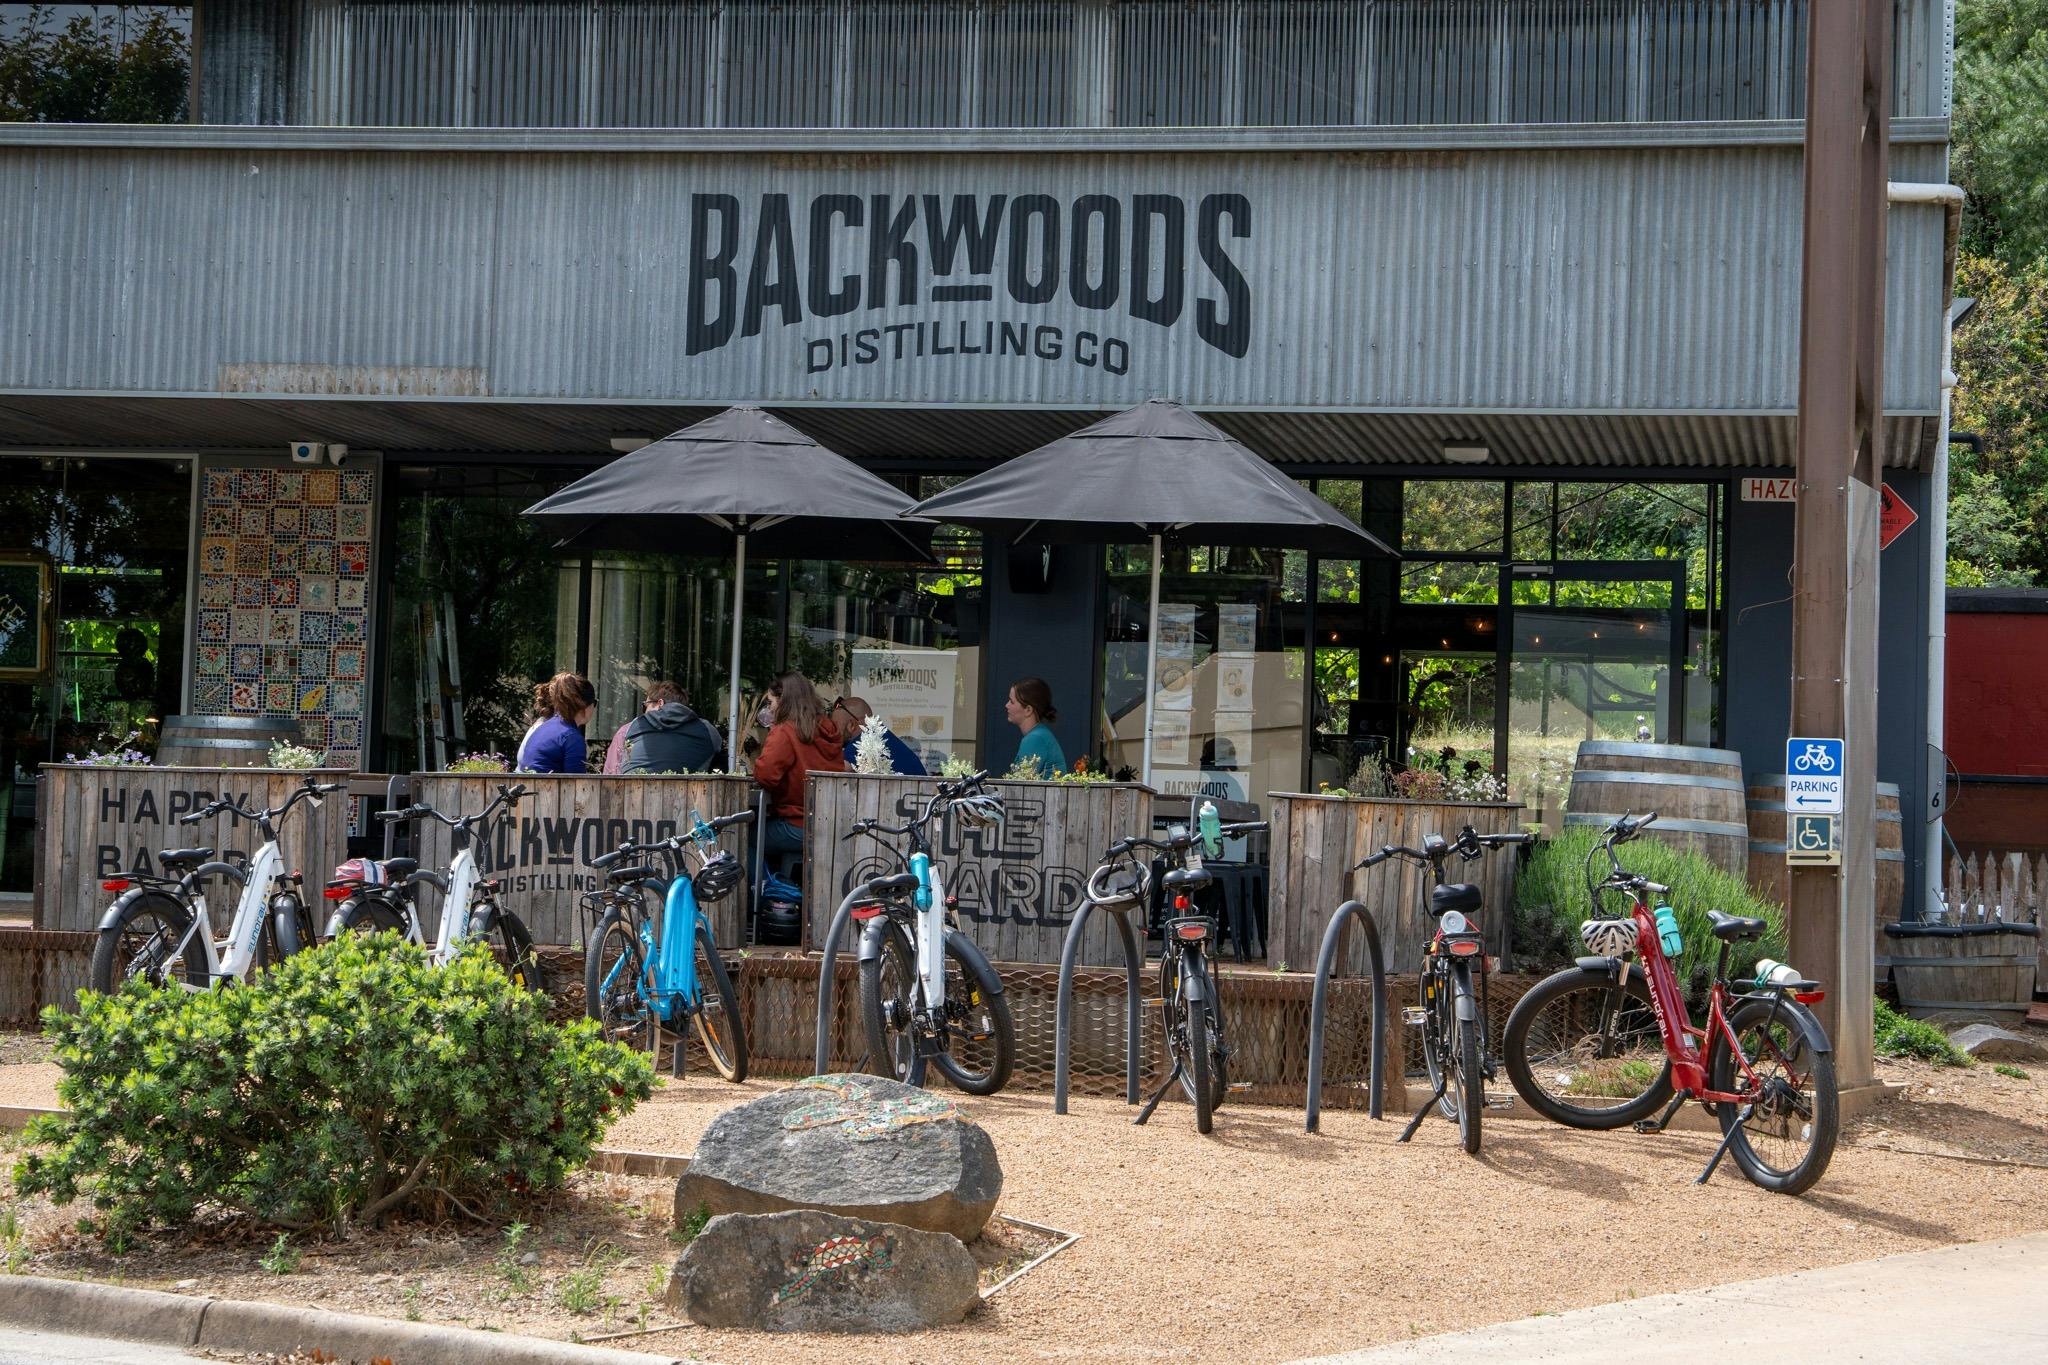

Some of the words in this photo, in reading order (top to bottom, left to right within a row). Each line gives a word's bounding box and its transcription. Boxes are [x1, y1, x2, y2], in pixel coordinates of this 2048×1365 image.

[686, 193, 1252, 358] BACKWOODS
[807, 321, 1062, 374] DISTILLING
[1074, 331, 1129, 376] CO
[1790, 780, 1838, 793] PARKING
[1931, 793, 1940, 808] 6
[473, 817, 677, 884] ACKWOODS
